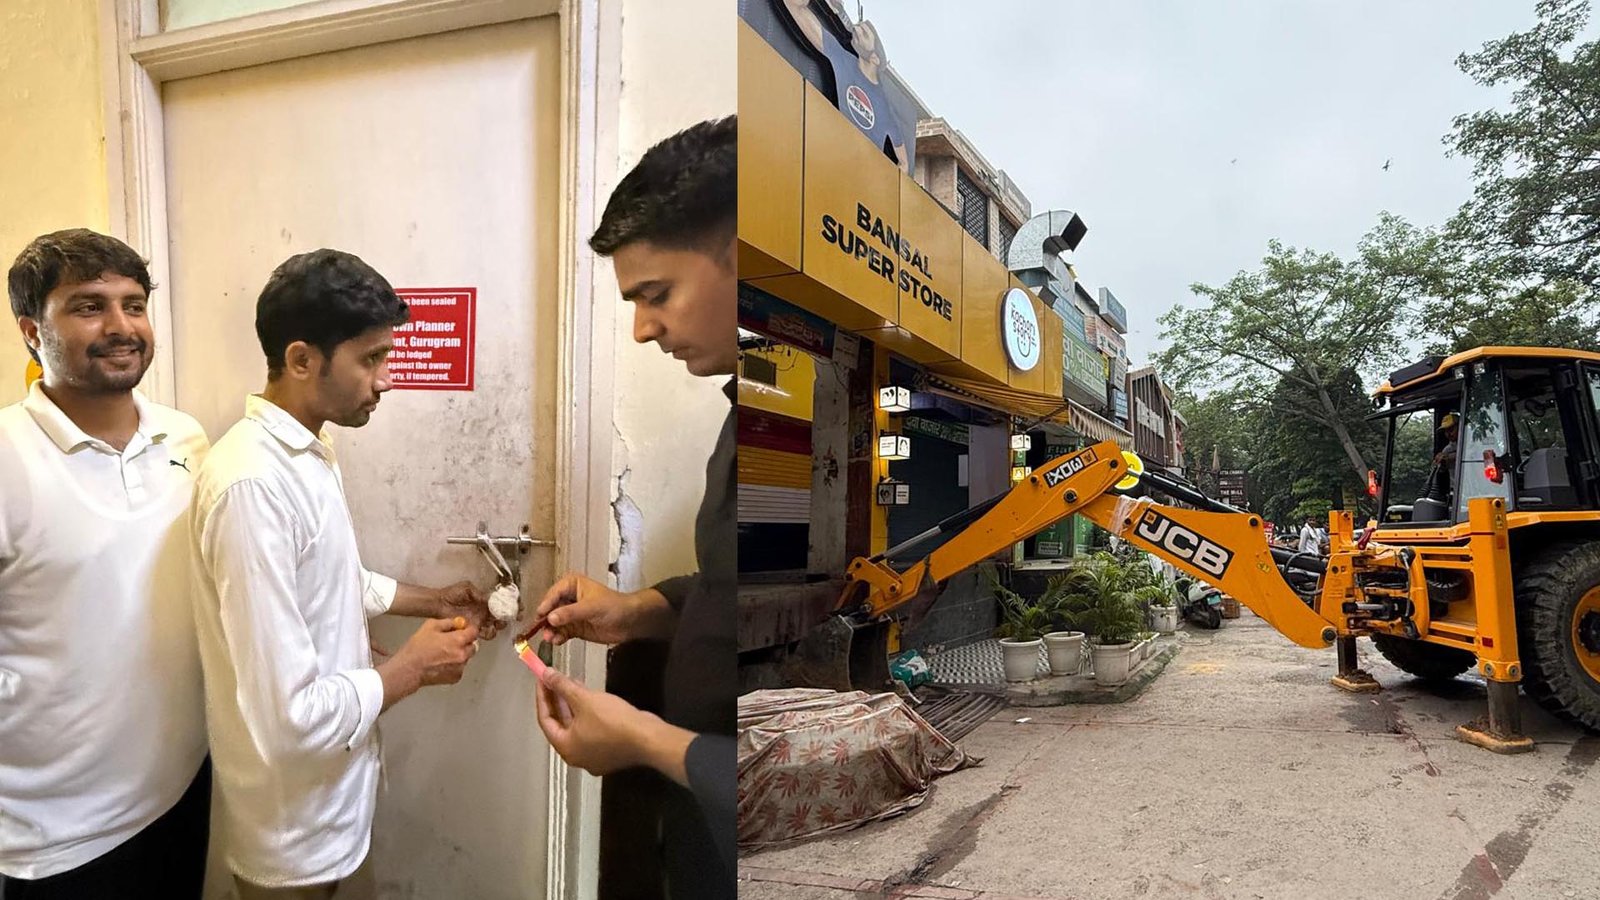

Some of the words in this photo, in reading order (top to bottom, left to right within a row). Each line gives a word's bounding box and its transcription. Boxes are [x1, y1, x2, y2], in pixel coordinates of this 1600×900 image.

[848, 92, 873, 122] PEPSI
[856, 202, 933, 281] BANSAL
[821, 214, 894, 284] SUPER
[898, 268, 953, 322] STORE
[411, 297, 430, 305] been
[431, 296, 457, 305] sealed
[392, 323, 414, 332] own
[415, 321, 456, 332] Planner
[409, 336, 461, 348] Gurugram
[406, 350, 432, 359] lodged
[388, 362, 414, 370] against
[415, 362, 427, 370] the
[428, 362, 452, 370] owner
[1138, 518, 1230, 576] JCB
